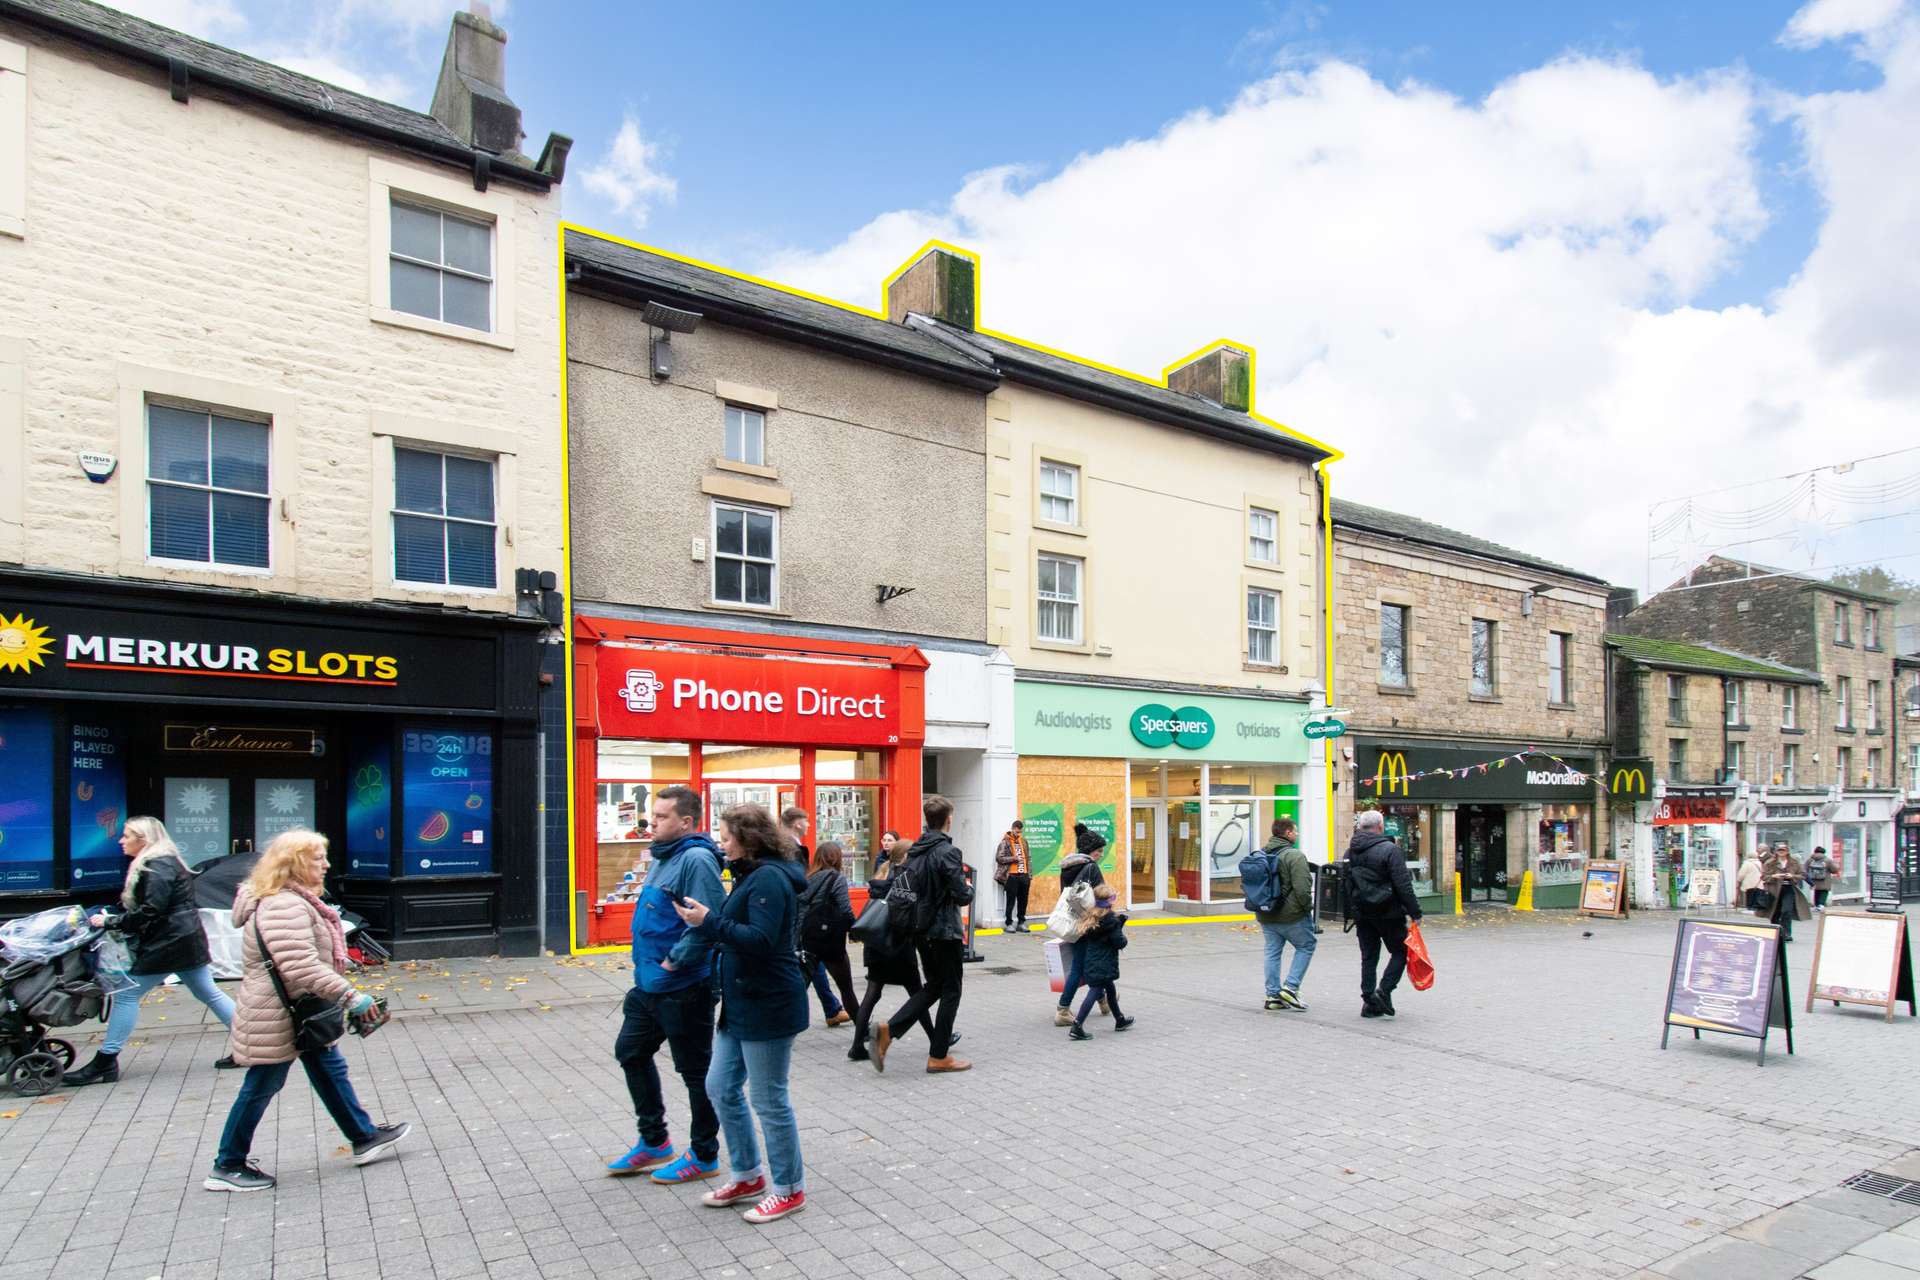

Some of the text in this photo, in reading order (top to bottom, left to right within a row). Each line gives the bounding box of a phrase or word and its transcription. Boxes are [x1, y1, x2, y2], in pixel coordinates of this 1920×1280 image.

[66, 634, 398, 680] MERKUR SLOTS
[673, 678, 886, 719] Phone Direct
[1035, 709, 1112, 733] Audiologists
[1139, 715, 1208, 735] Specsavers
[73, 725, 109, 737] BINGO
[1236, 721, 1281, 739] Opticians
[1307, 725, 1341, 735] Specsavers
[190, 725, 295, 750] Entrance
[888, 735, 898, 743] 20
[73, 741, 115, 754] PLAYED
[438, 743, 462, 754] 24h
[73, 757, 103, 769] HERE
[431, 767, 468, 777] OPEN
[1526, 770, 1586, 785] McDonald's
[175, 825, 220, 833] SLOTS
